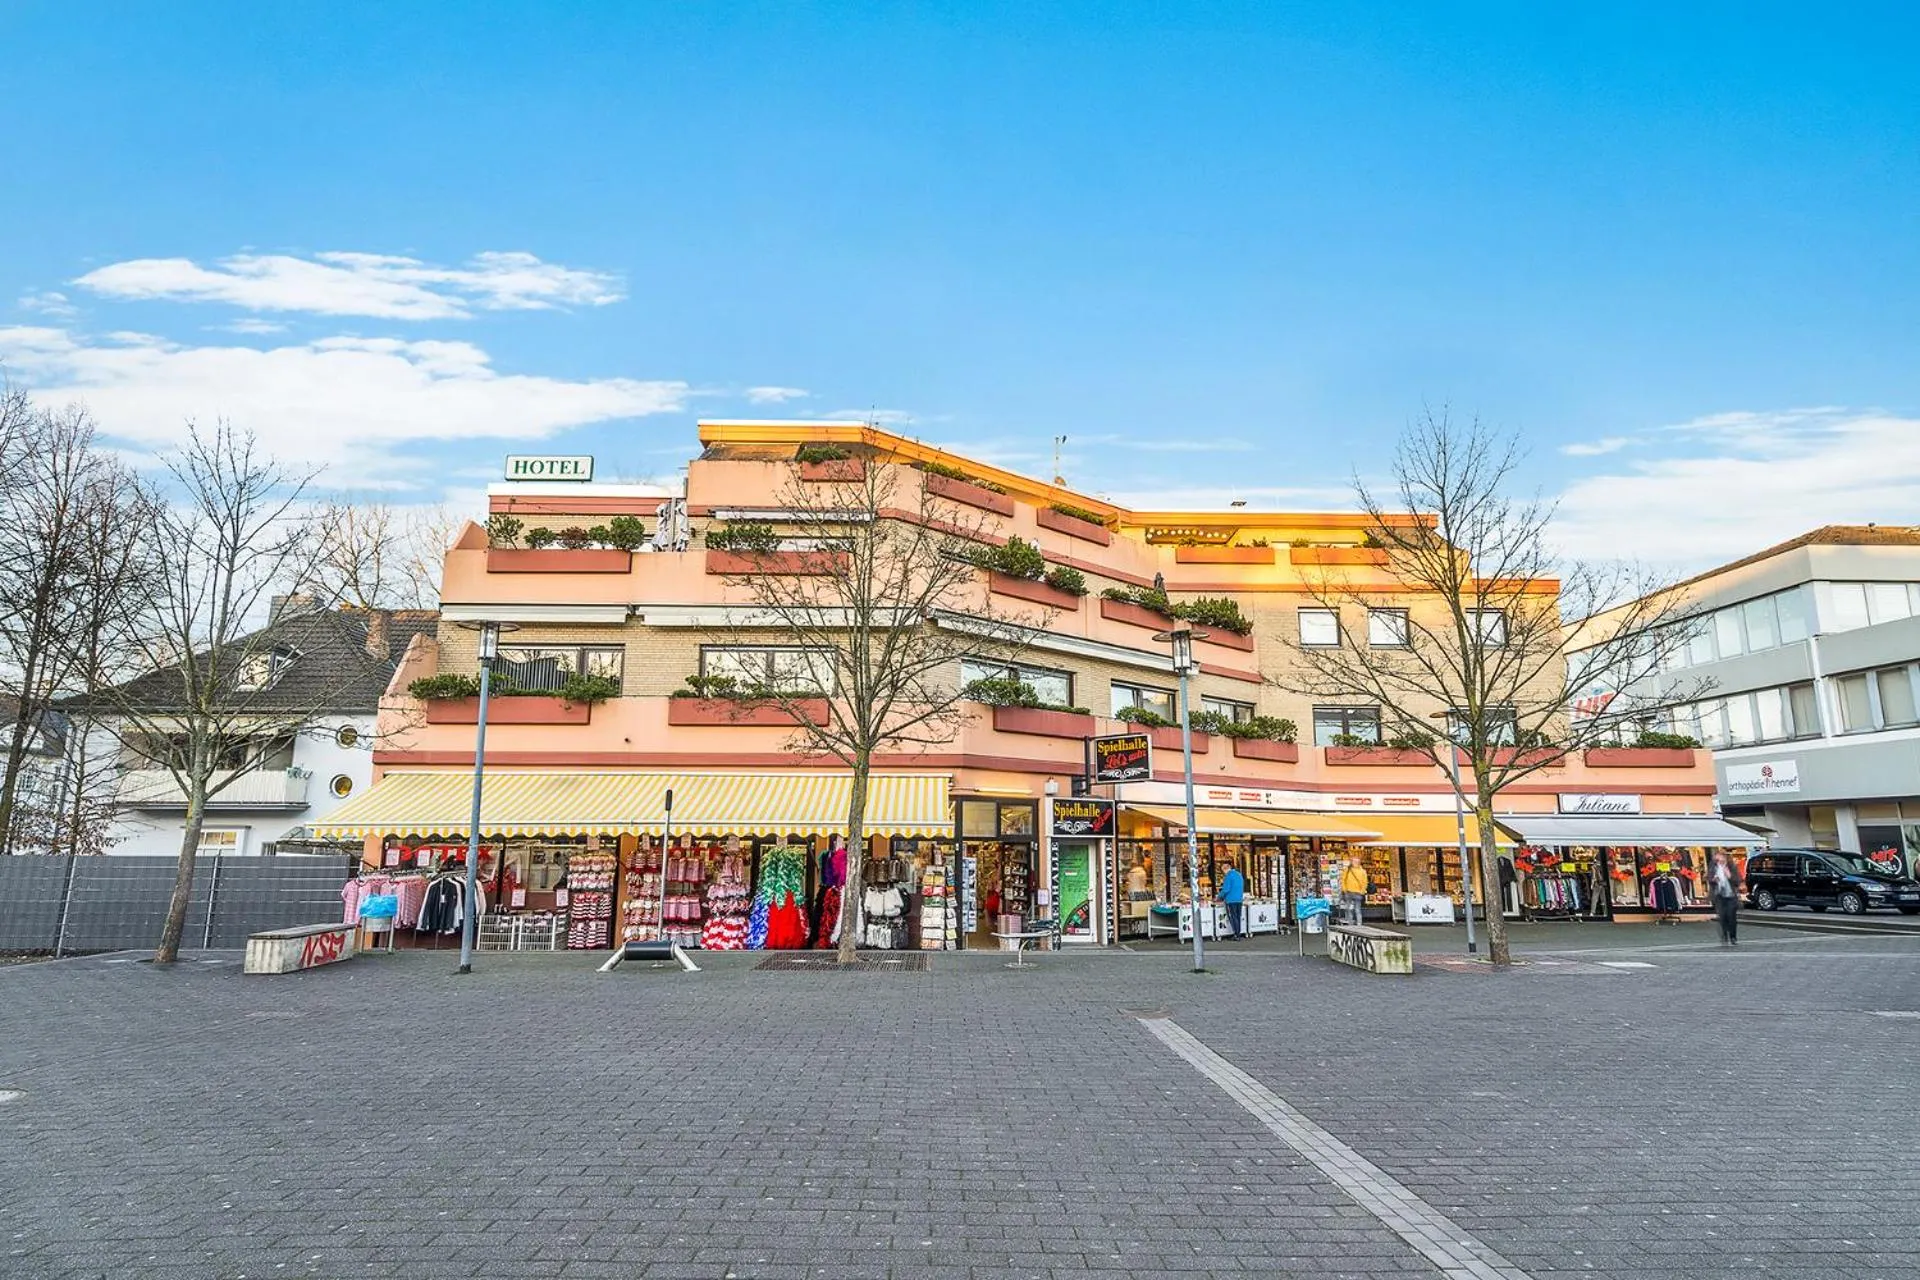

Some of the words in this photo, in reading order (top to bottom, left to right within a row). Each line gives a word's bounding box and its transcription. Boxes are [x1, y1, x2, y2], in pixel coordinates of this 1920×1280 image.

[513, 460, 585, 474] HOTEL
[1097, 738, 1147, 756] Spielhalle
[1054, 802, 1100, 820] Spielhalle
[1576, 794, 1629, 812] Juliane
[1105, 841, 1113, 938] SPIELHALLE
